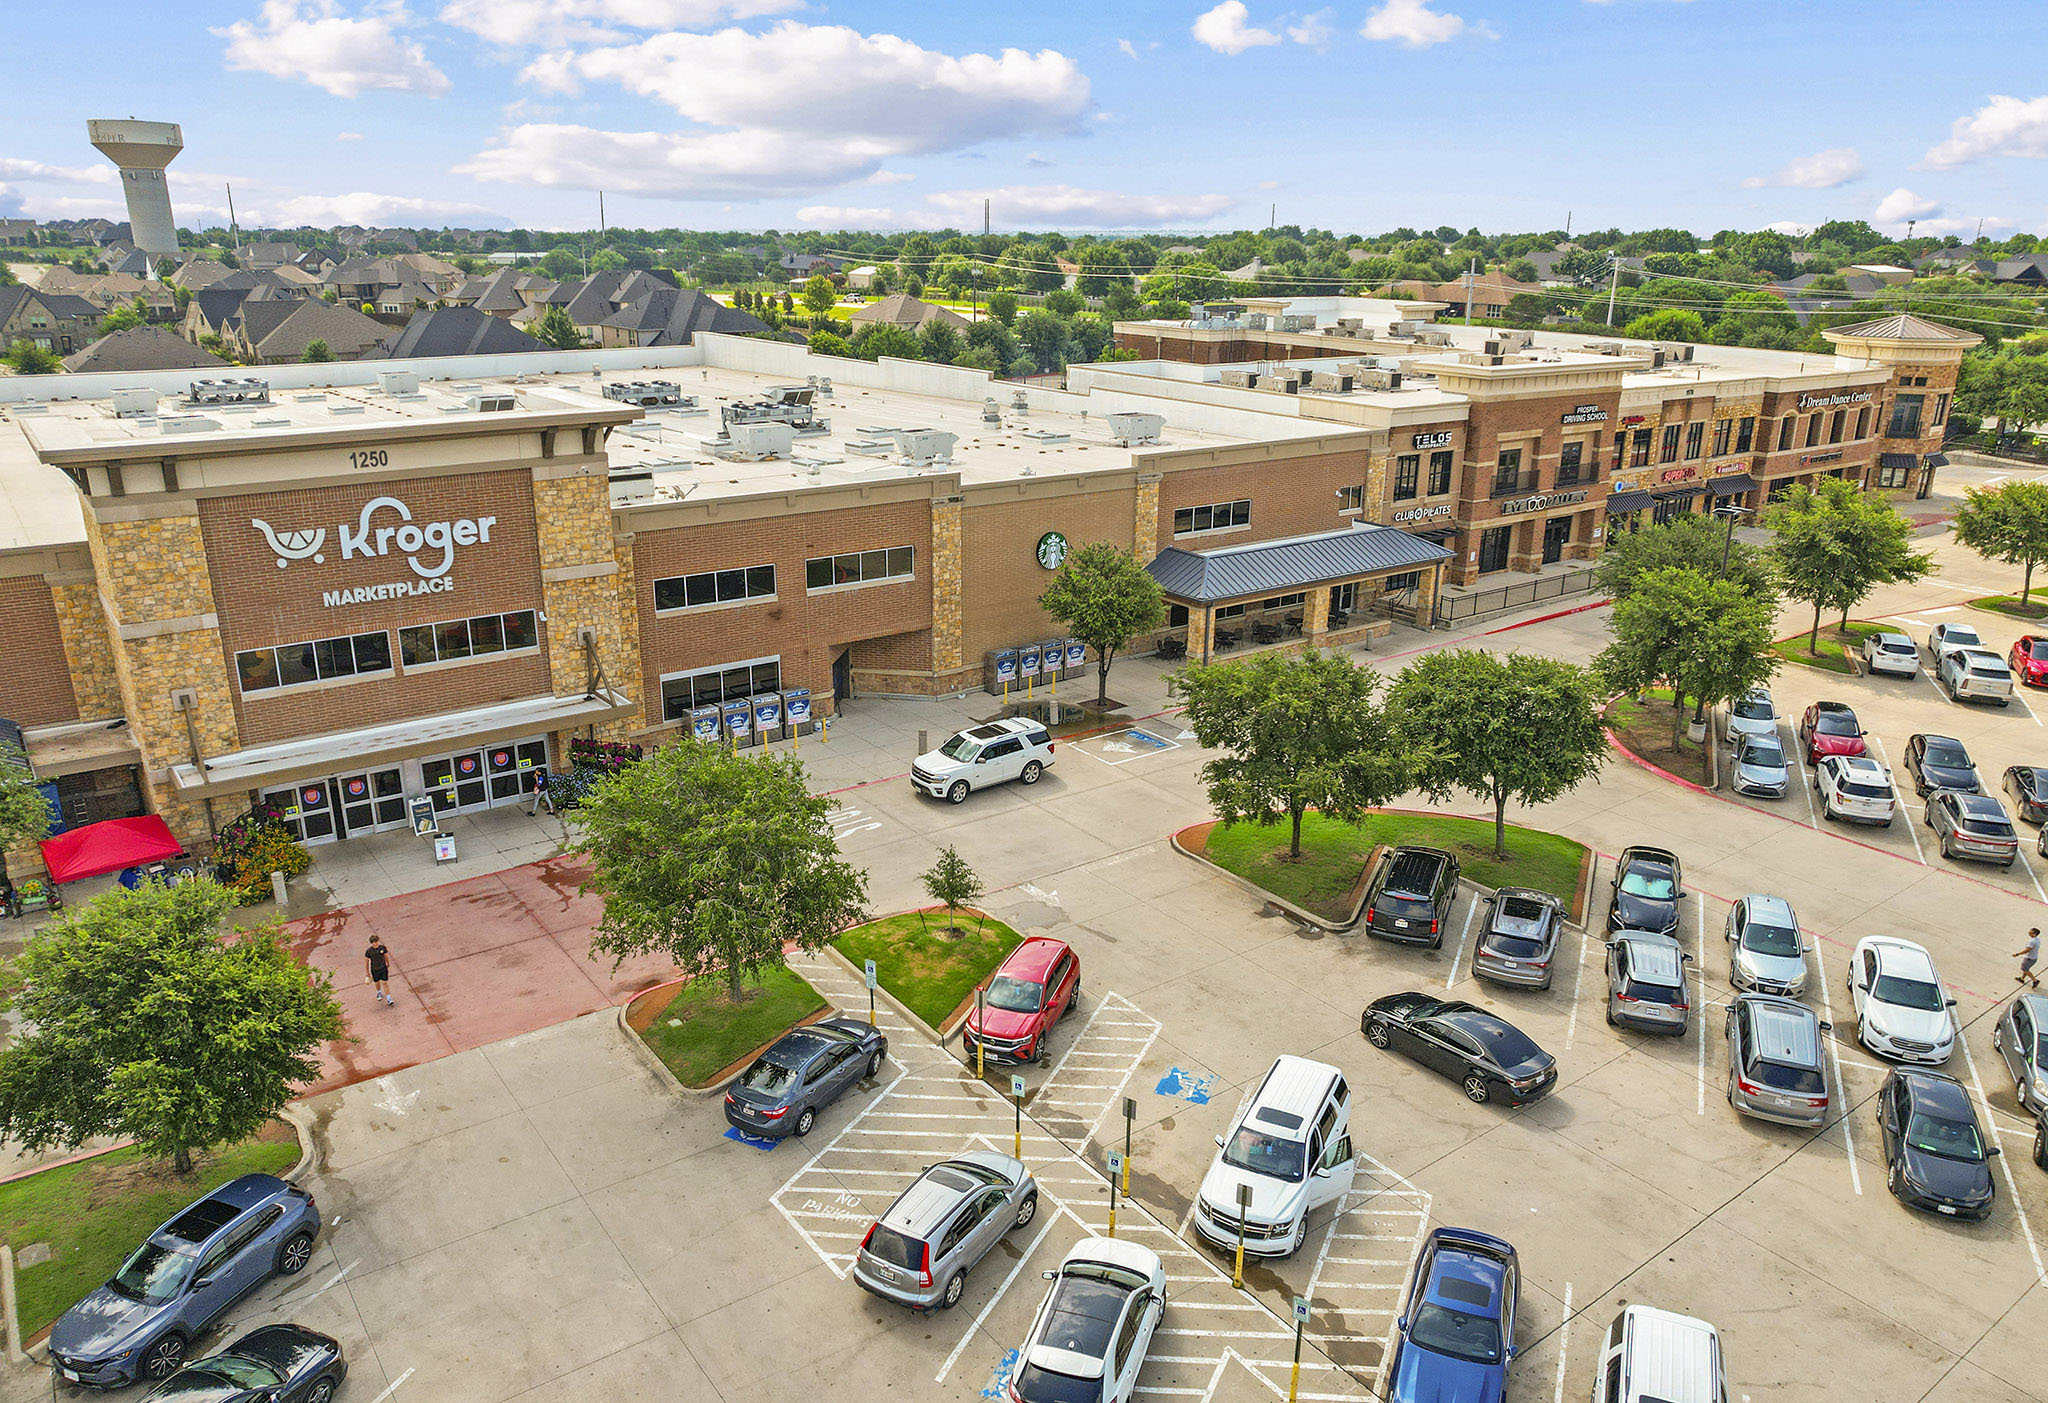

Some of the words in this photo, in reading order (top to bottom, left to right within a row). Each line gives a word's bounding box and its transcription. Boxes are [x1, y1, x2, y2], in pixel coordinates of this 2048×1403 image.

[1806, 397, 1829, 408] Dream
[1830, 394, 1850, 405] Dance
[1851, 392, 1872, 402] Center
[1576, 405, 1598, 414] PROSPER
[1563, 414, 1585, 424] DRIVING
[1586, 412, 1608, 421] SCHOOL
[1415, 432, 1452, 445] TELOS
[349, 449, 388, 469] 1250
[1395, 510, 1415, 521] CLUB
[1423, 505, 1451, 518] PILATES
[338, 496, 496, 578] Kroger
[323, 577, 454, 608] MARKETPLACE
[835, 1192, 861, 1208] NO
